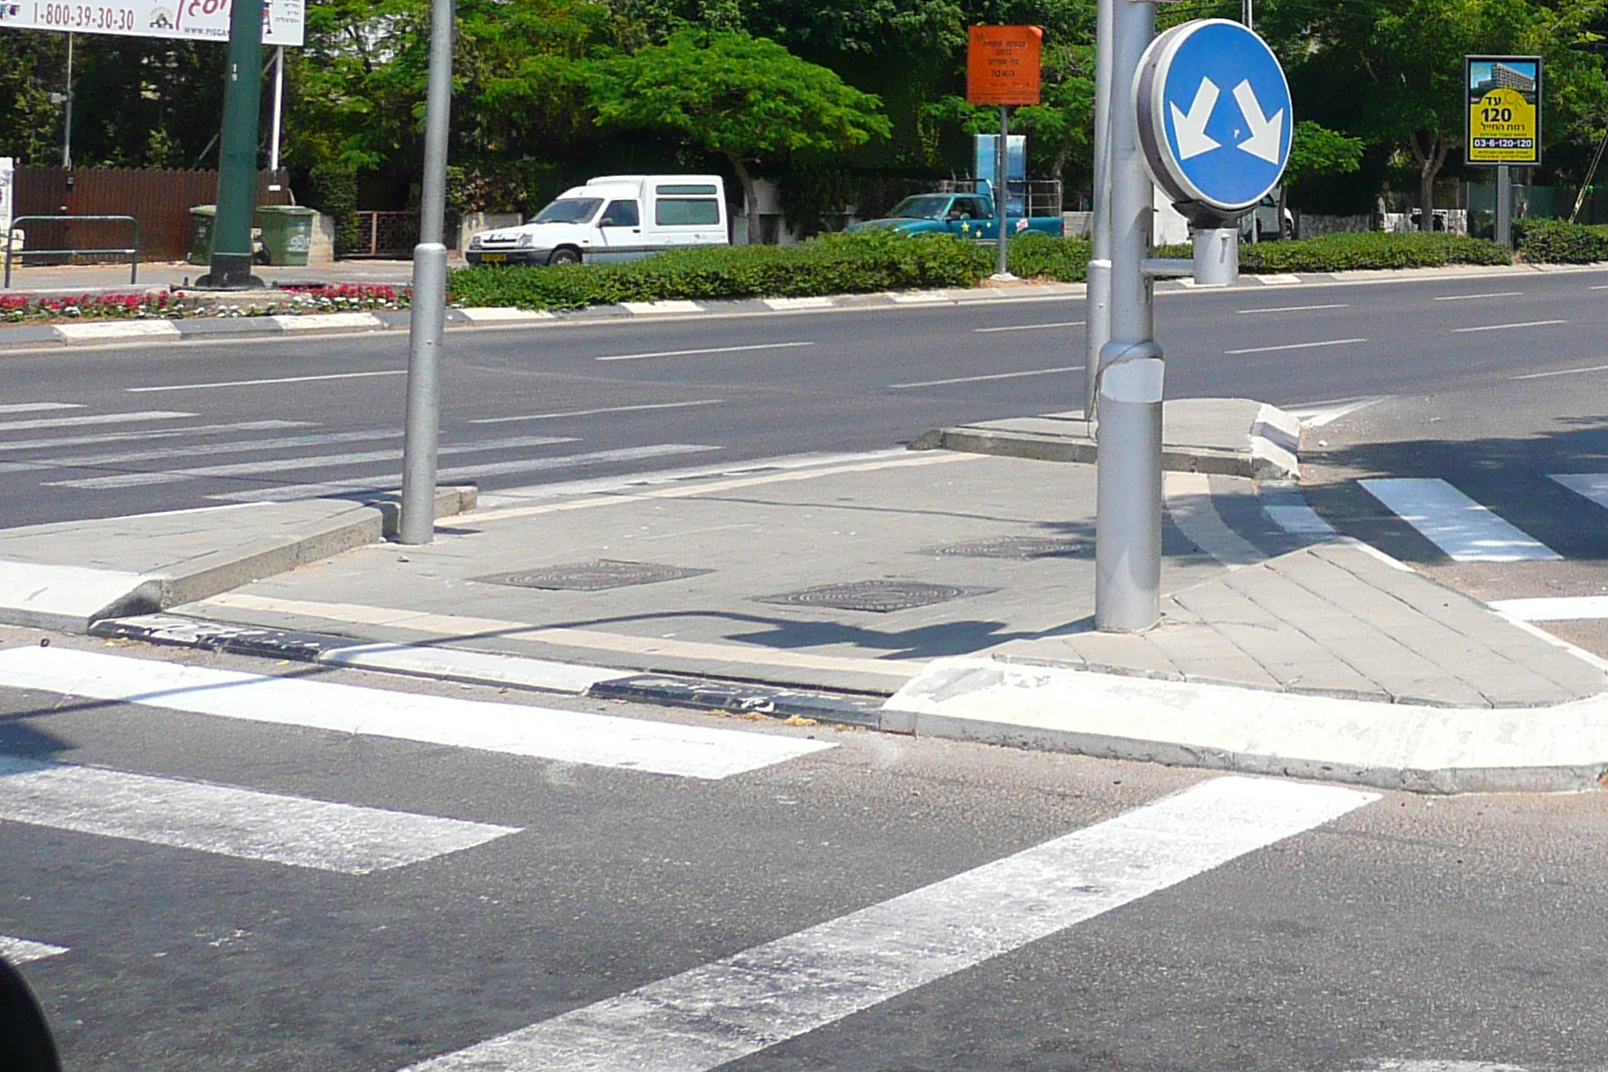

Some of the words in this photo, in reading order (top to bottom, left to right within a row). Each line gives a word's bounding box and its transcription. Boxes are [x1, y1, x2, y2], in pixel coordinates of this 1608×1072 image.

[1485, 96, 1502, 106] עד
[1481, 108, 1512, 122] 120
[1474, 139, 1532, 147] 03-6-120-120
